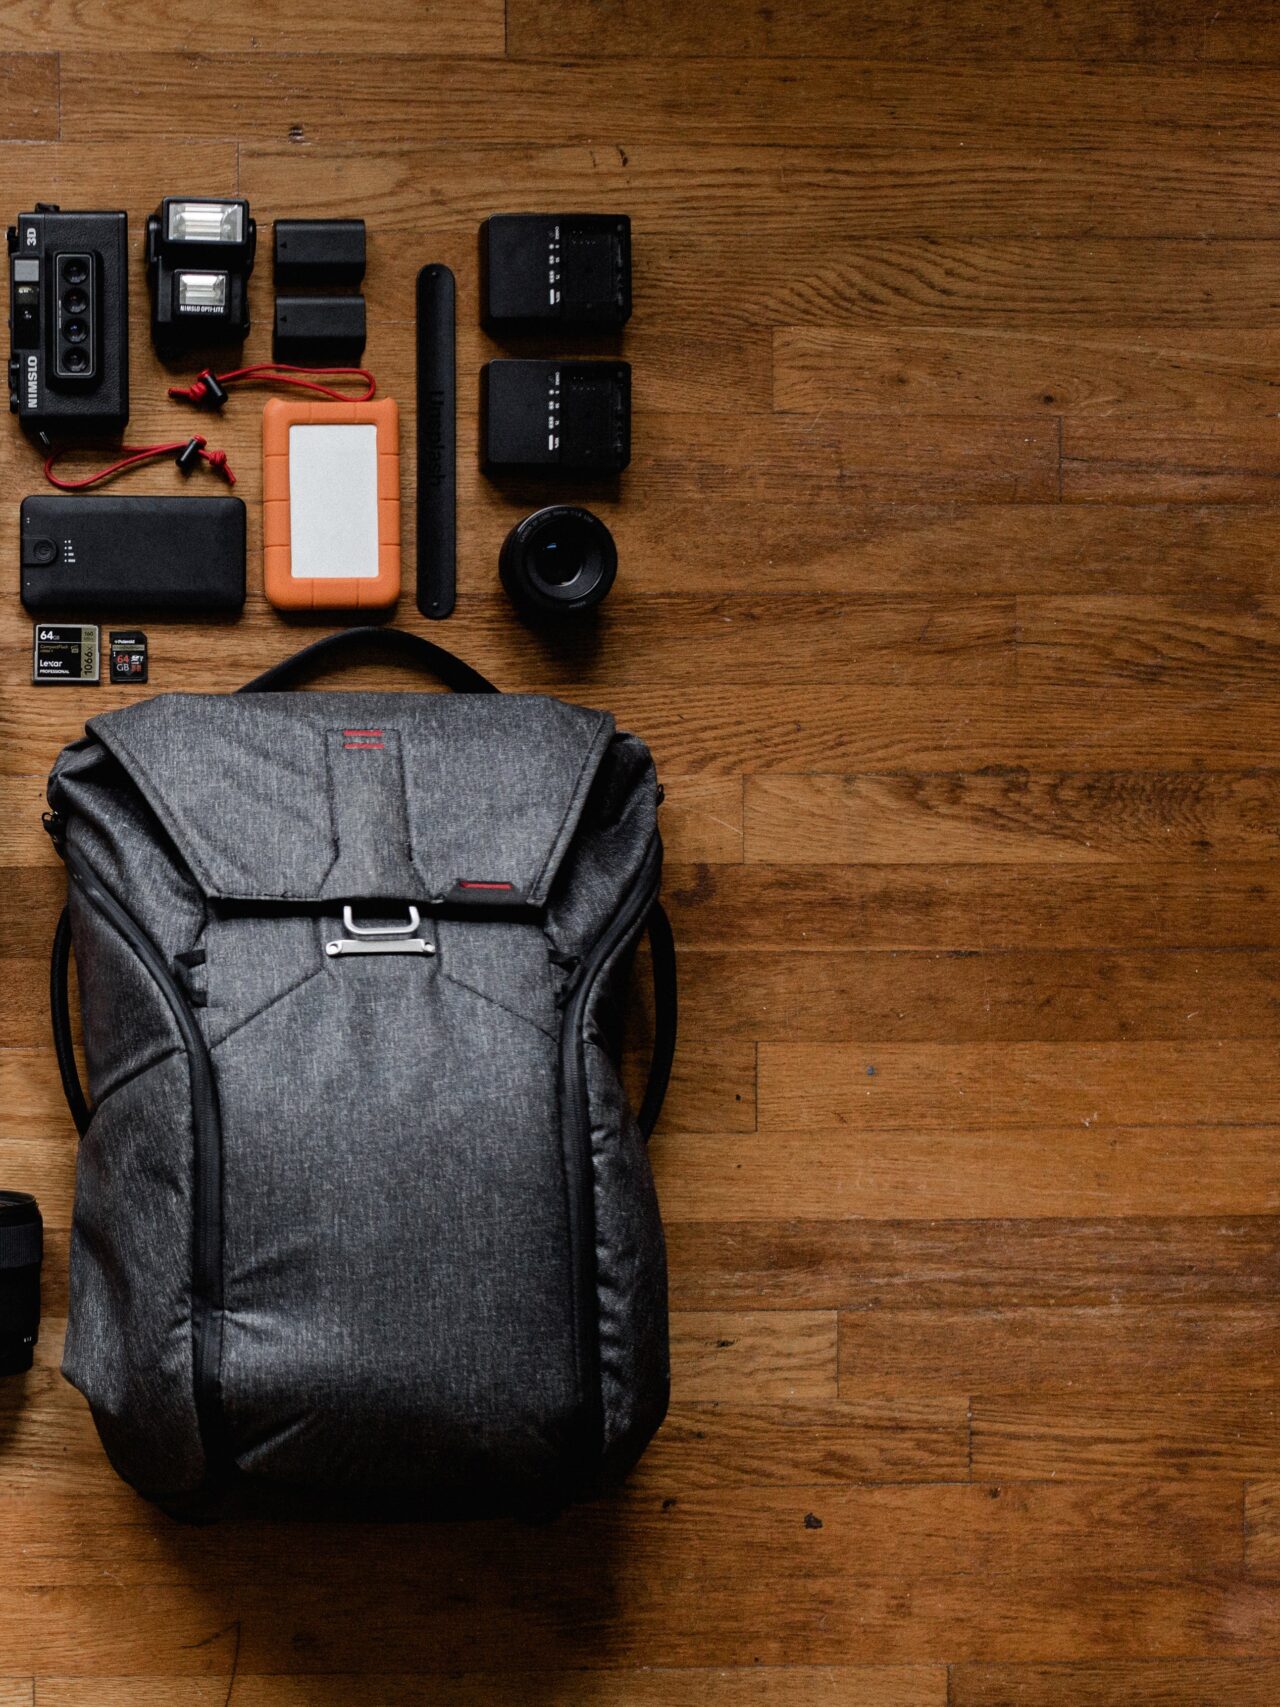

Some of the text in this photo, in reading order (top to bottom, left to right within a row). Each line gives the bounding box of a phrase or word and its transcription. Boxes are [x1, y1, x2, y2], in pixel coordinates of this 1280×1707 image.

[27, 227, 38, 409] NIMSLO 3D
[427, 391, 445, 487] Unsplash
[39, 659, 63, 668] Lexar
[84, 646, 93, 675] 1066x
[116, 663, 130, 672] GB
[117, 655, 129, 663] 64
